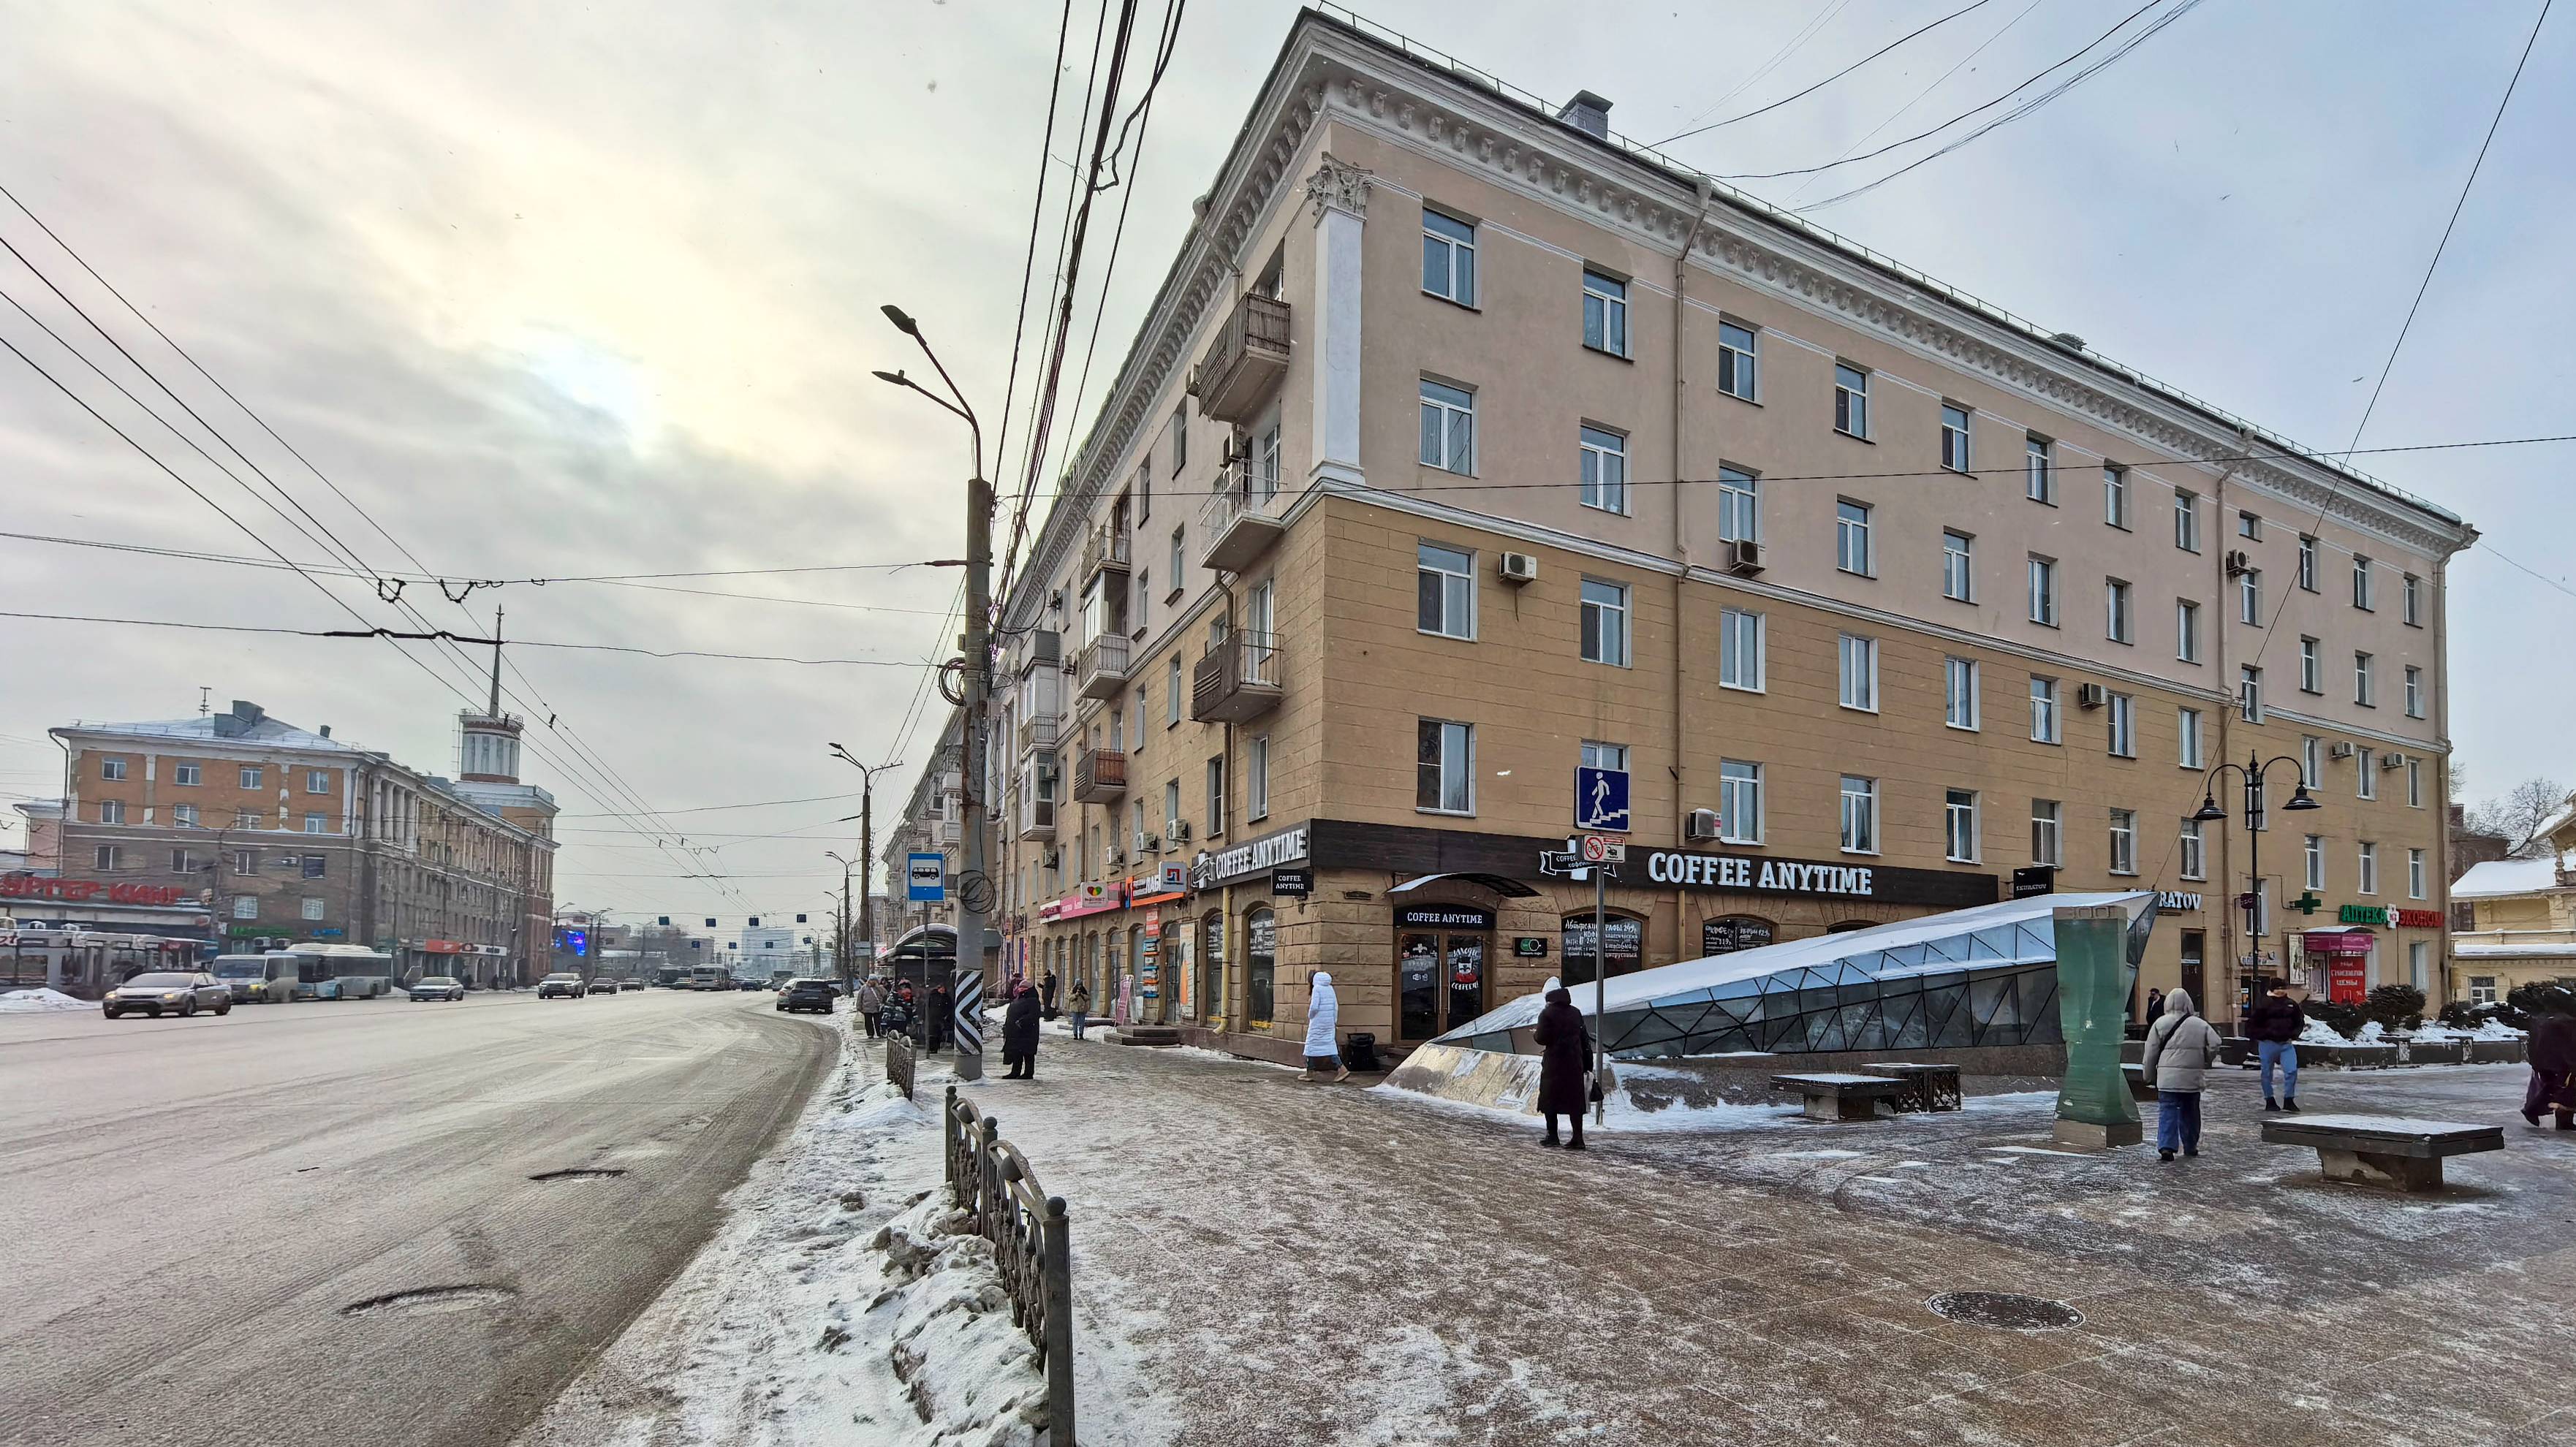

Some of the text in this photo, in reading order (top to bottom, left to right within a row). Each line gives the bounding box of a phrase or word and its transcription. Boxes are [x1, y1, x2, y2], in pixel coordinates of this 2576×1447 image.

[1215, 846, 1252, 879] COFFEE
[1251, 827, 1307, 870] ANYTIME
[1648, 851, 1873, 895] COFFEE ANYTIME
[2158, 890, 2202, 911] RATOV
[1407, 912, 1482, 924] COFFEE ANYTIME
[2342, 905, 2388, 924] АПТЕКА
[2400, 908, 2445, 927] ЭКОНОМ
